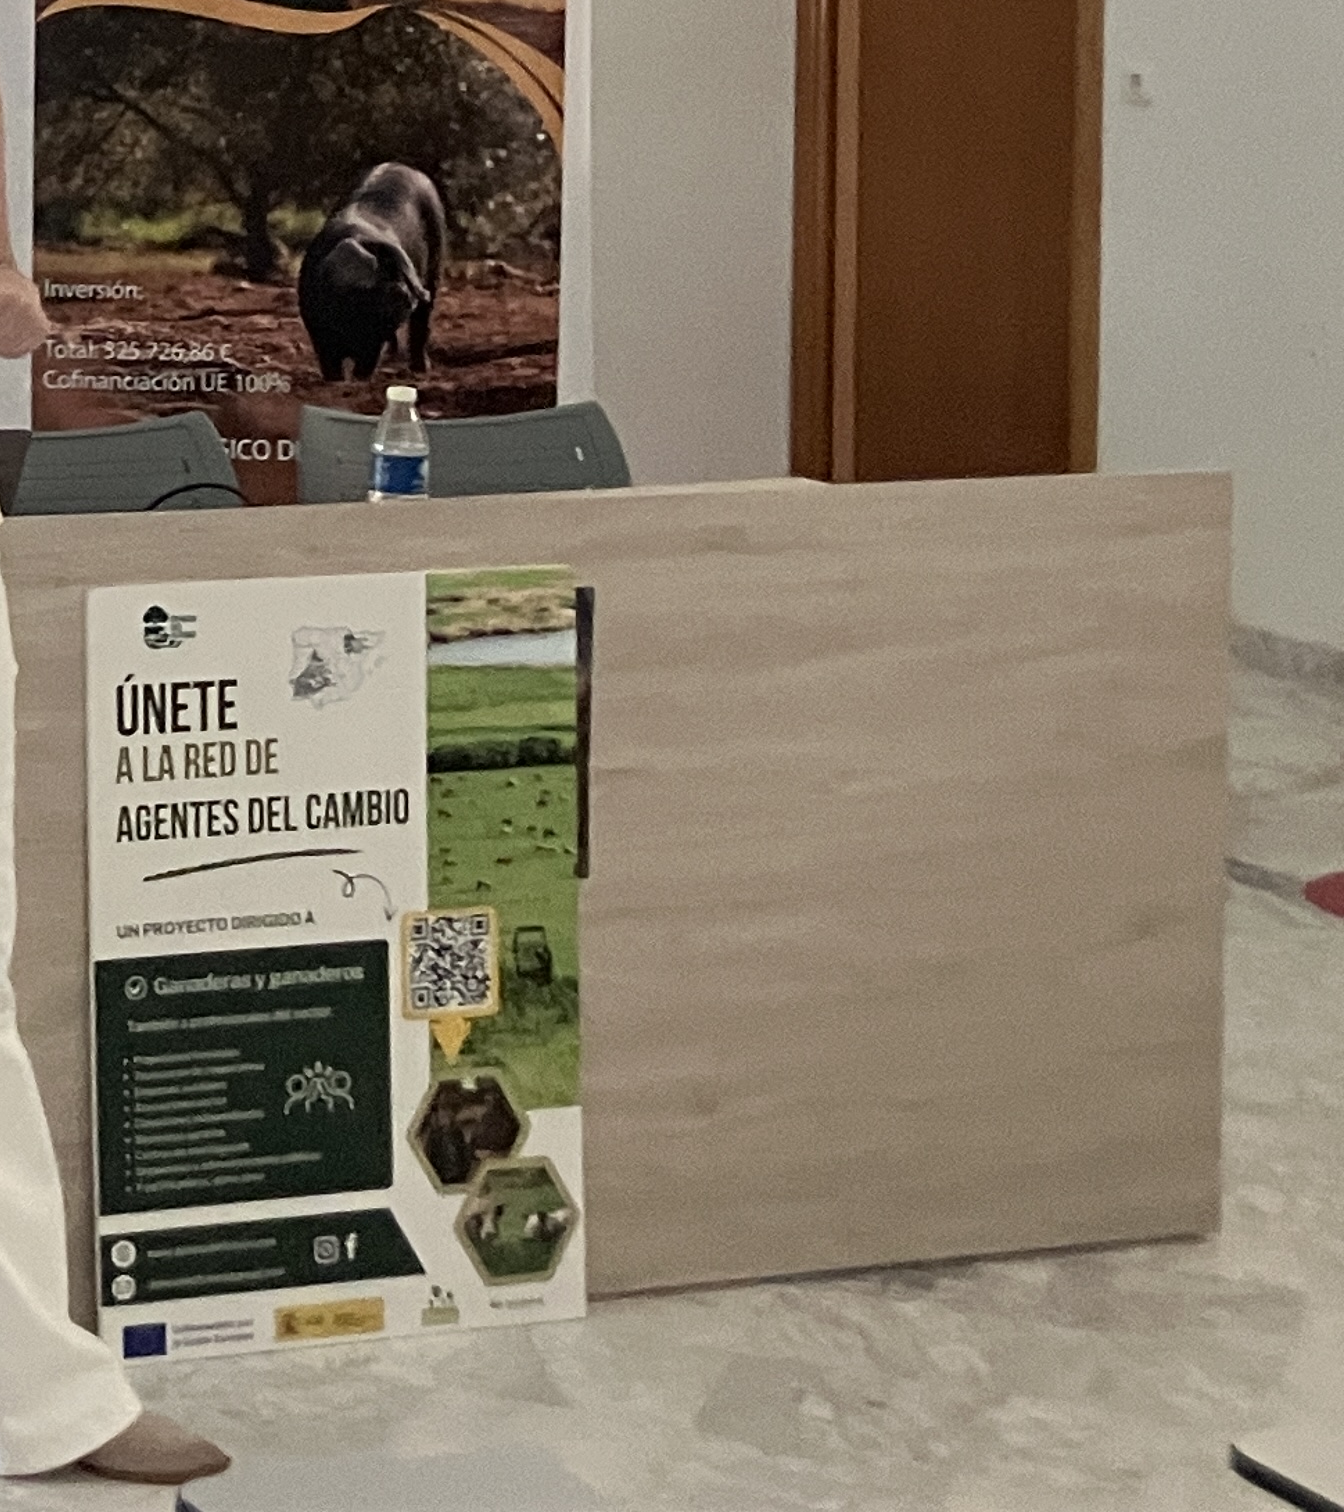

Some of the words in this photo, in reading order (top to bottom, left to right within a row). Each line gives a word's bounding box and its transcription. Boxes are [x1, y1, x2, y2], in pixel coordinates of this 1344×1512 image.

[43, 278, 144, 300] Inversión:
[42, 369, 196, 392] Cofinanciación
[200, 372, 228, 392] UE
[235, 371, 293, 394] 100%
[115, 674, 239, 737] ÚNETE
[115, 745, 134, 785] A
[142, 742, 176, 783] LA
[184, 739, 237, 780] RED
[245, 737, 280, 776] DE
[115, 798, 240, 845] AGENTES
[247, 794, 298, 835] DEL
[304, 787, 411, 828] CAMBIO
[116, 924, 139, 939] UN
[142, 916, 229, 938] PROYECTO
